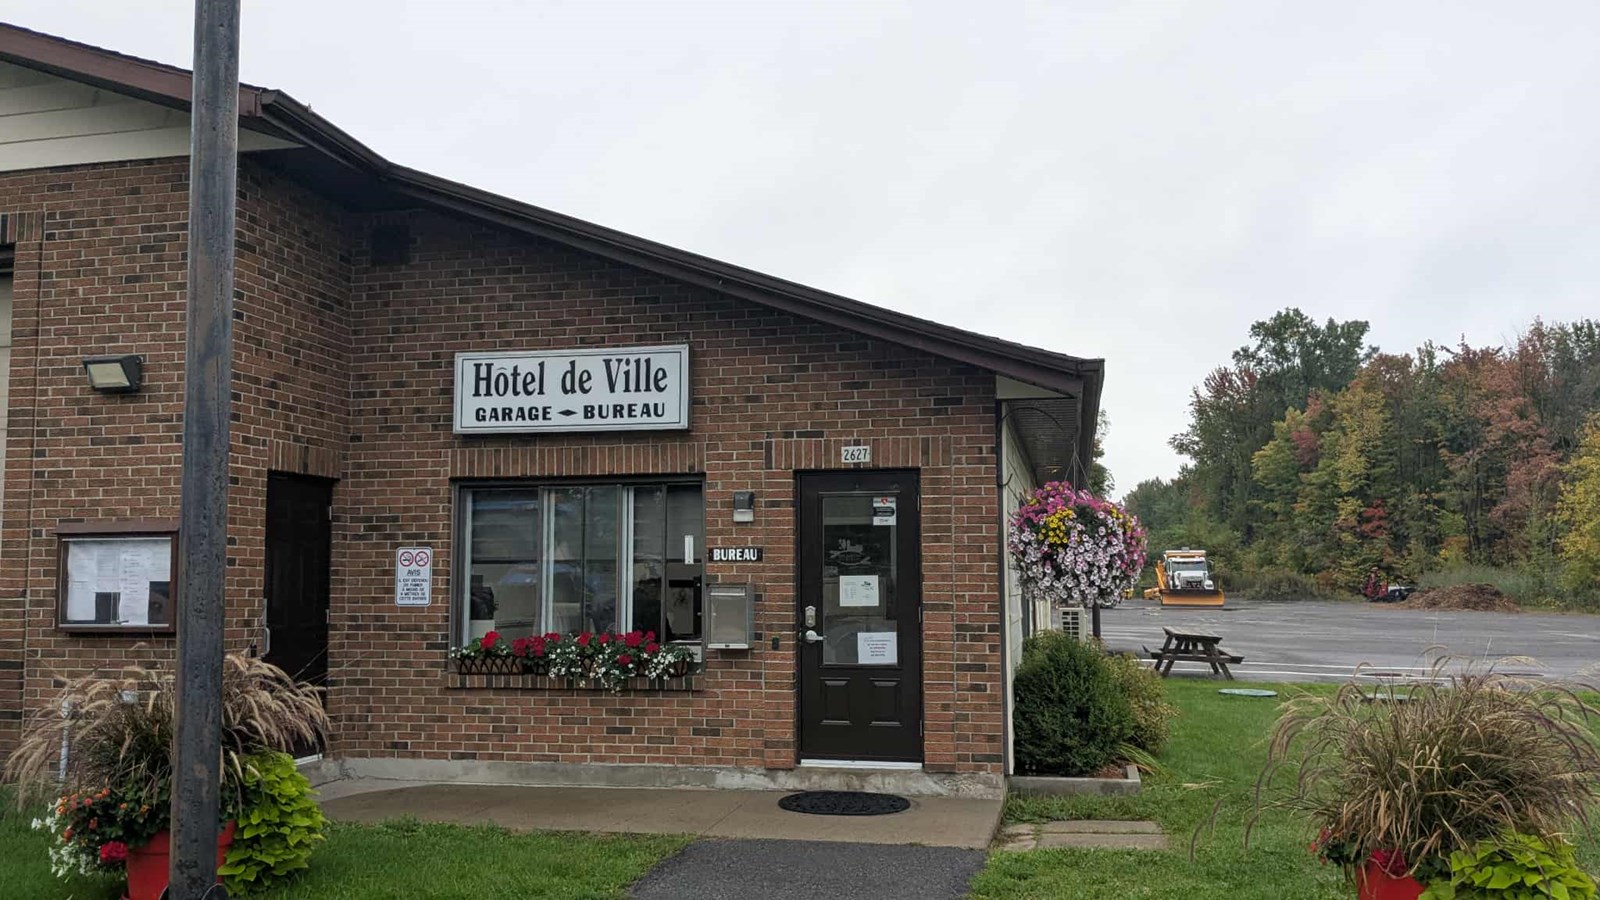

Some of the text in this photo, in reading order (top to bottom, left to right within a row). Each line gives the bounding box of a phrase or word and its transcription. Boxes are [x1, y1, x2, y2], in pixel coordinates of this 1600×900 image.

[472, 357, 668, 397] Hôtel de Ville
[475, 402, 665, 422] GARAGE BUREAU
[844, 448, 868, 461] 2627
[713, 548, 757, 561] BUREAU
